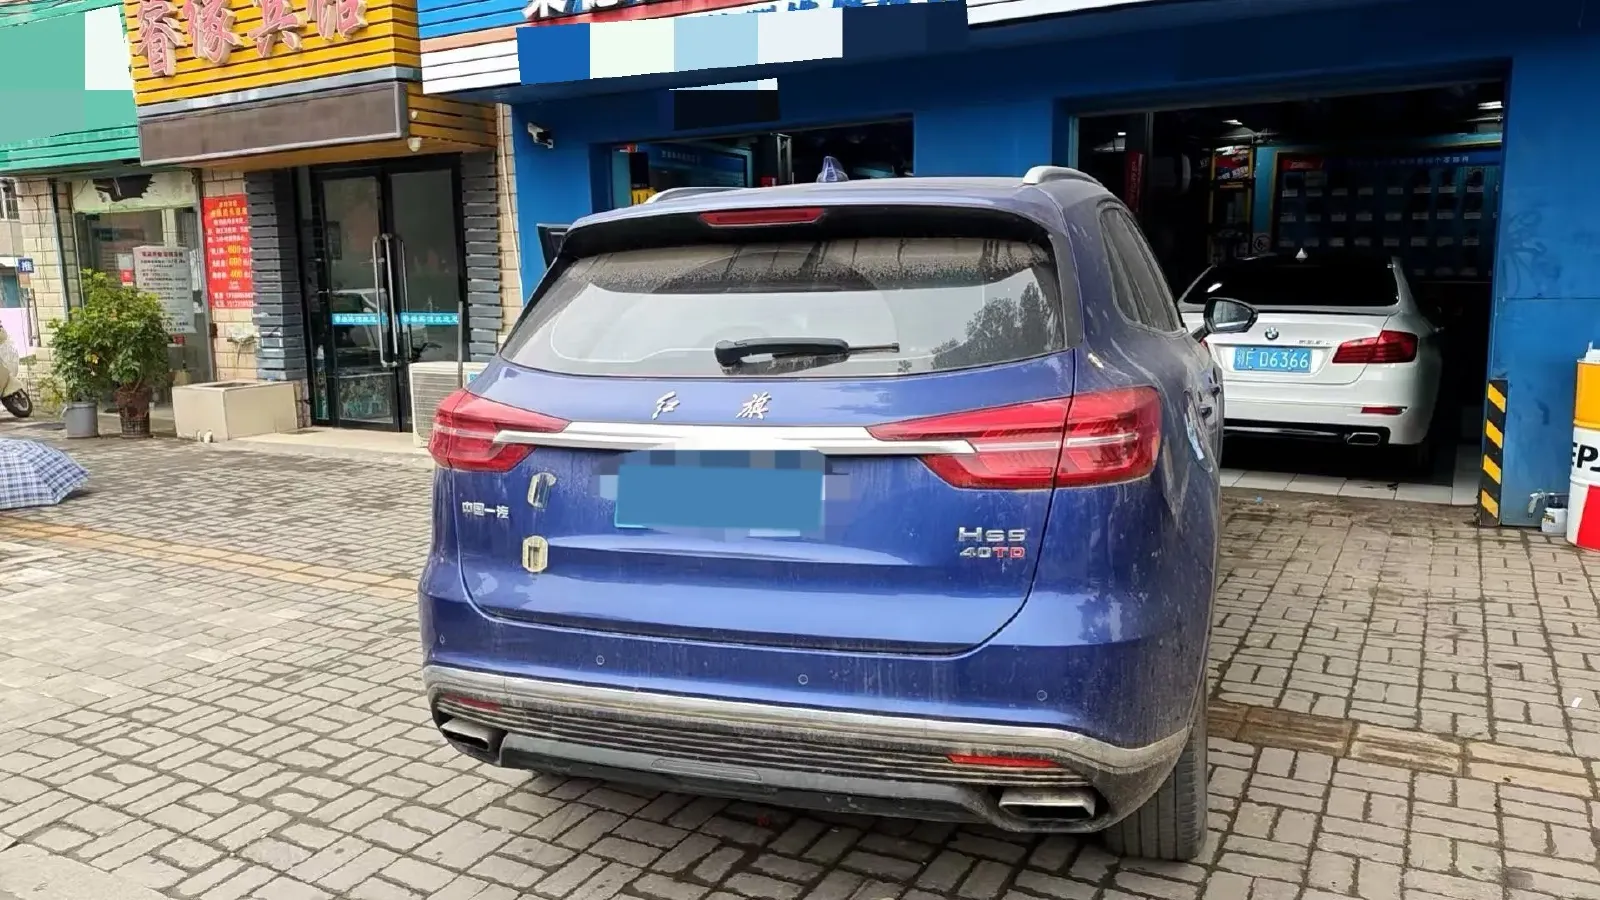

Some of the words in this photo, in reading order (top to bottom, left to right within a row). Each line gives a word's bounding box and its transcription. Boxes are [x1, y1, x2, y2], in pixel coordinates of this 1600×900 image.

[1259, 351, 1309, 368] D6366
[461, 501, 509, 519] 中国一汽
[959, 546, 1026, 558] 40TD
